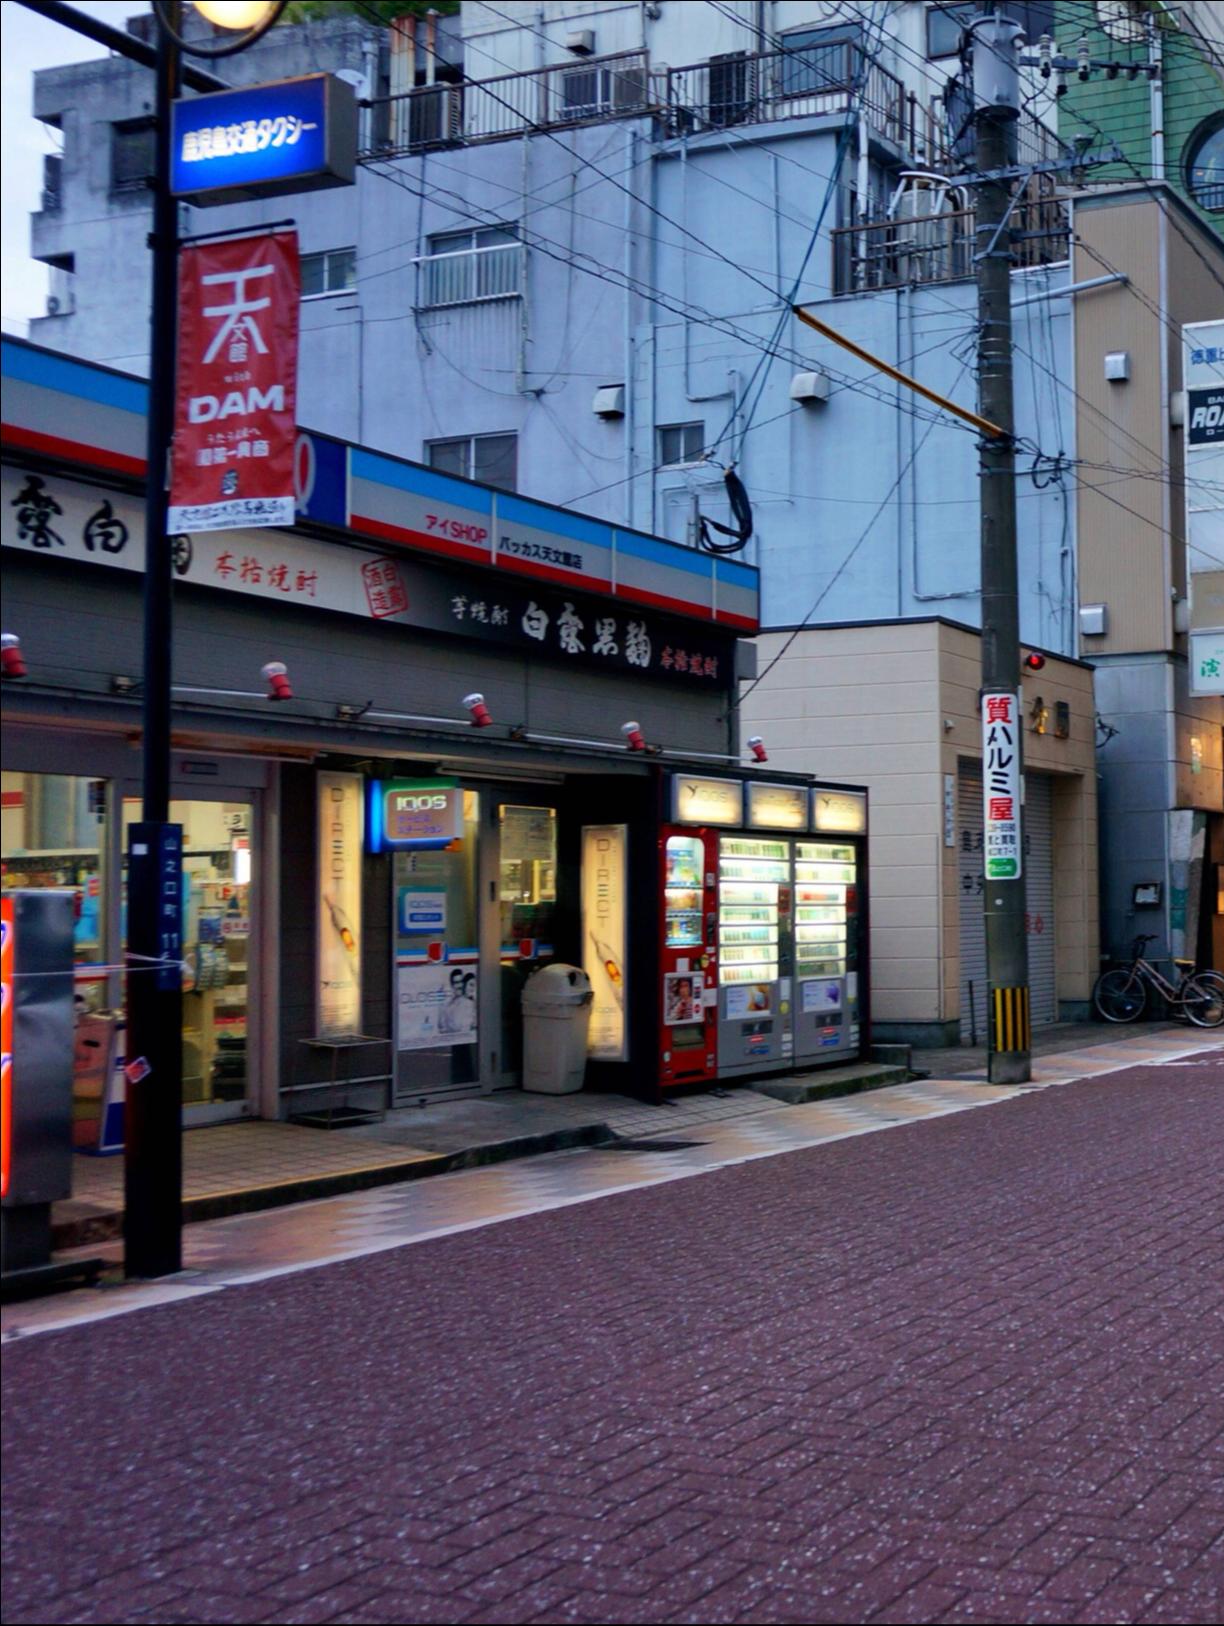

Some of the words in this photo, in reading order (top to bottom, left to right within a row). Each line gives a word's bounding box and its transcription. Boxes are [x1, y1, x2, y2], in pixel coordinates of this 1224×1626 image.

[188, 385, 284, 424] DAM
[425, 514, 488, 545] アイSHOP
[214, 551, 318, 597] 本格焼酎
[451, 595, 509, 626] 芋焼酎
[986, 697, 1014, 821] 質ハルミ屋
[396, 795, 447, 812] IQOS
[164, 838, 177, 917] 山之口町
